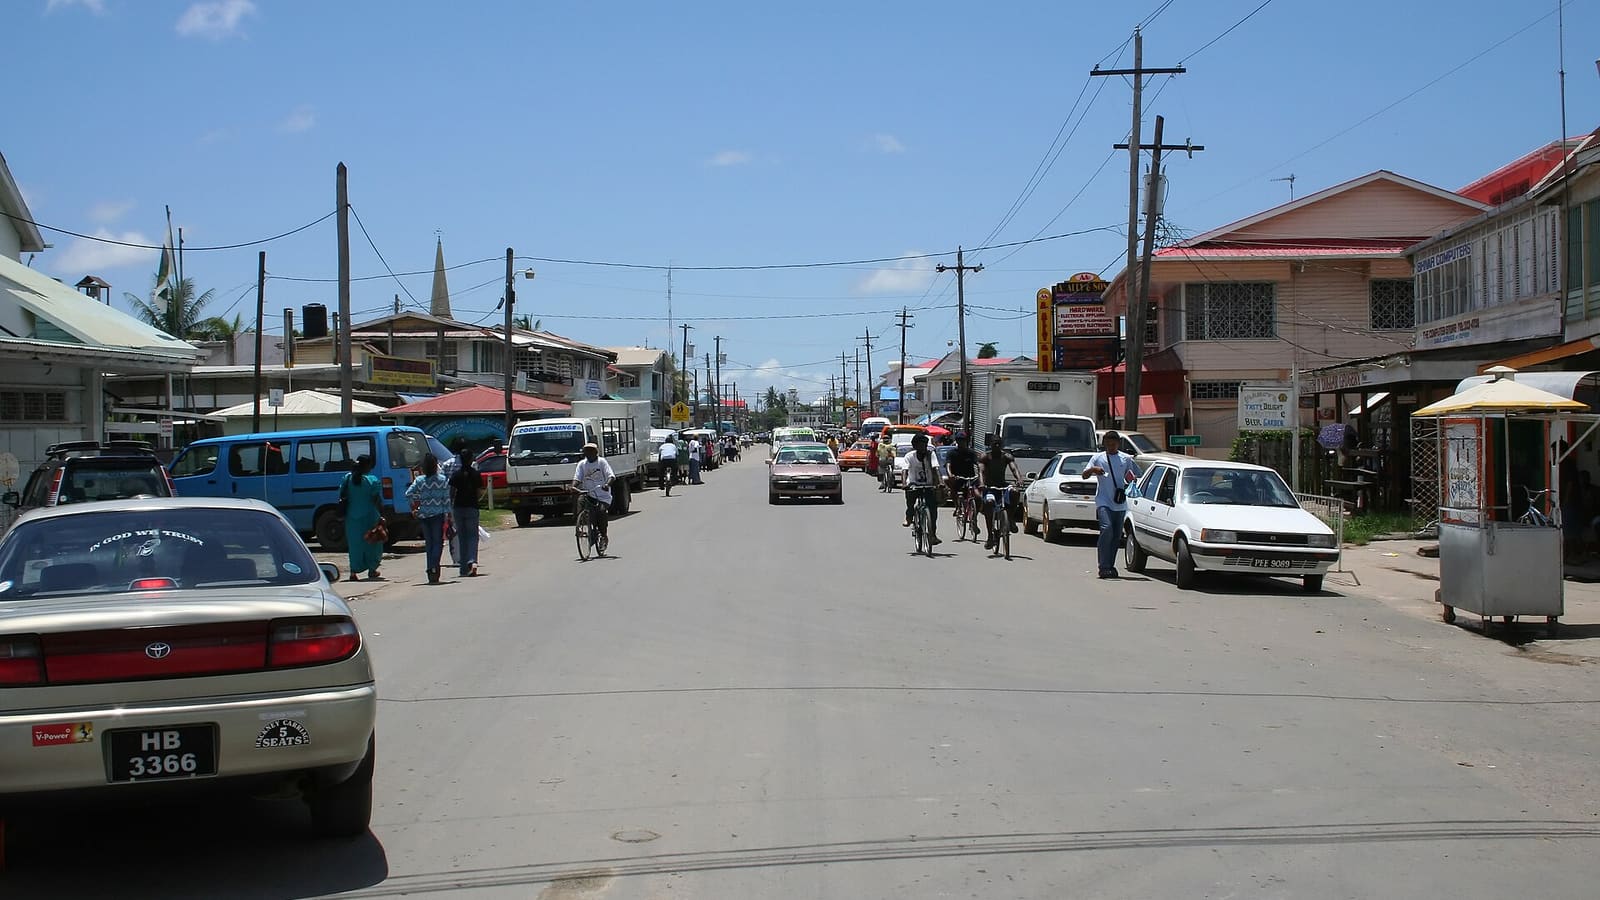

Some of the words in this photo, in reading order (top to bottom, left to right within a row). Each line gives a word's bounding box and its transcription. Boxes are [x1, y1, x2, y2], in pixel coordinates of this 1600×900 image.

[1436, 242, 1472, 266] COMPUTERS
[89, 542, 101, 552] IN
[102, 532, 132, 545] GOD
[161, 529, 205, 546] TRUST
[35, 732, 70, 741] V-Power
[141, 730, 181, 751] HB
[262, 736, 303, 748] SEATS
[279, 726, 288, 738] 5
[282, 720, 309, 744] CARRIAGE
[129, 753, 197, 776] 3366
